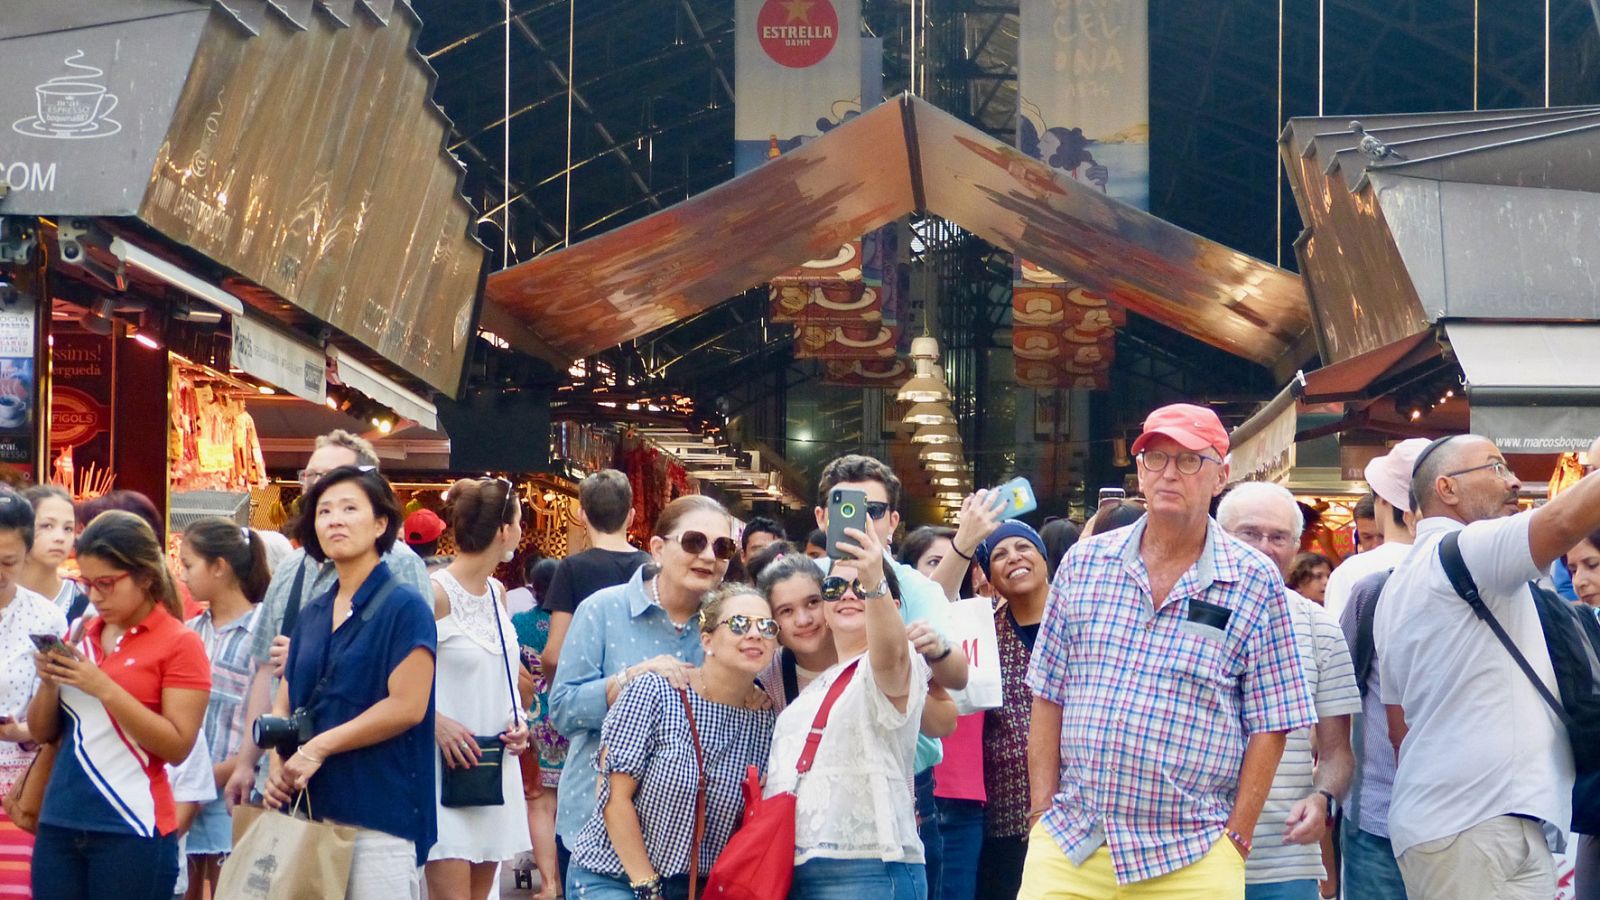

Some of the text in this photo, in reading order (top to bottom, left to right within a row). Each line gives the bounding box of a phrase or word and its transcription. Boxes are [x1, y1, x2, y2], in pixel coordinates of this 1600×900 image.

[763, 25, 833, 39] ESTRELLA
[785, 39, 811, 47] DAMM
[1495, 436, 1596, 450] www.marcosboquer
